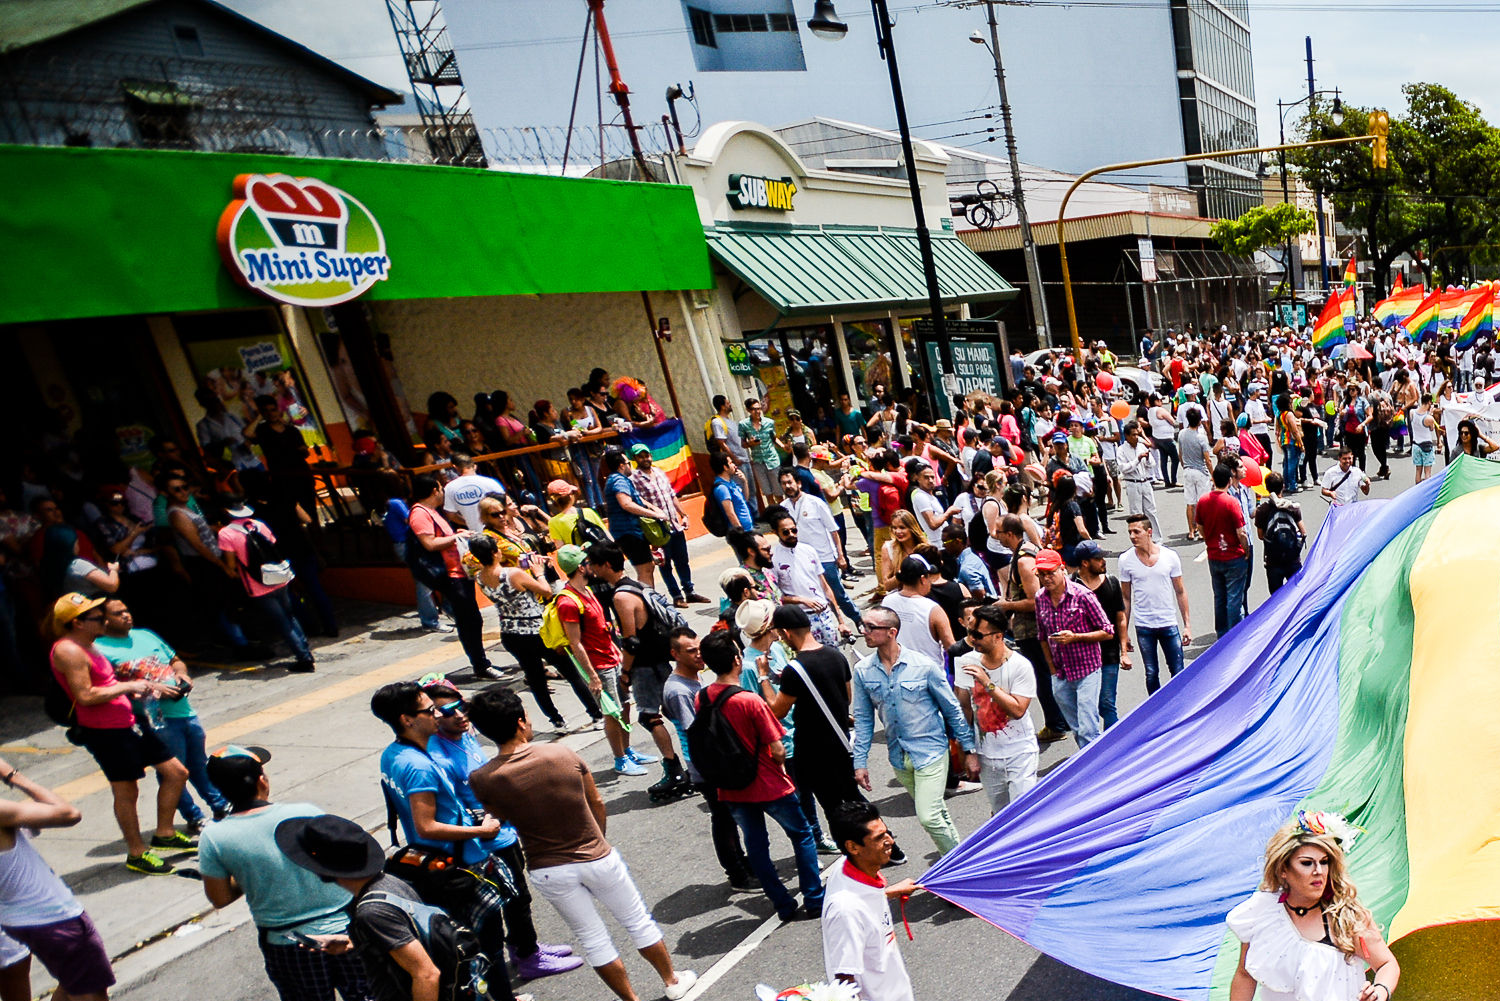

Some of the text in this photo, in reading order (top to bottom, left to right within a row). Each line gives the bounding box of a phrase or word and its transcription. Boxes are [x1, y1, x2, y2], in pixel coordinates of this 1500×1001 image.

[738, 176, 797, 210] SUBWAY
[244, 250, 387, 286] Mini Super
[954, 346, 965, 361] SU
[966, 347, 990, 362] MANO
[730, 363, 751, 371] kolbi
[958, 364, 974, 375] SOLO
[975, 364, 994, 376] PARA
[456, 489, 478, 500] intel
